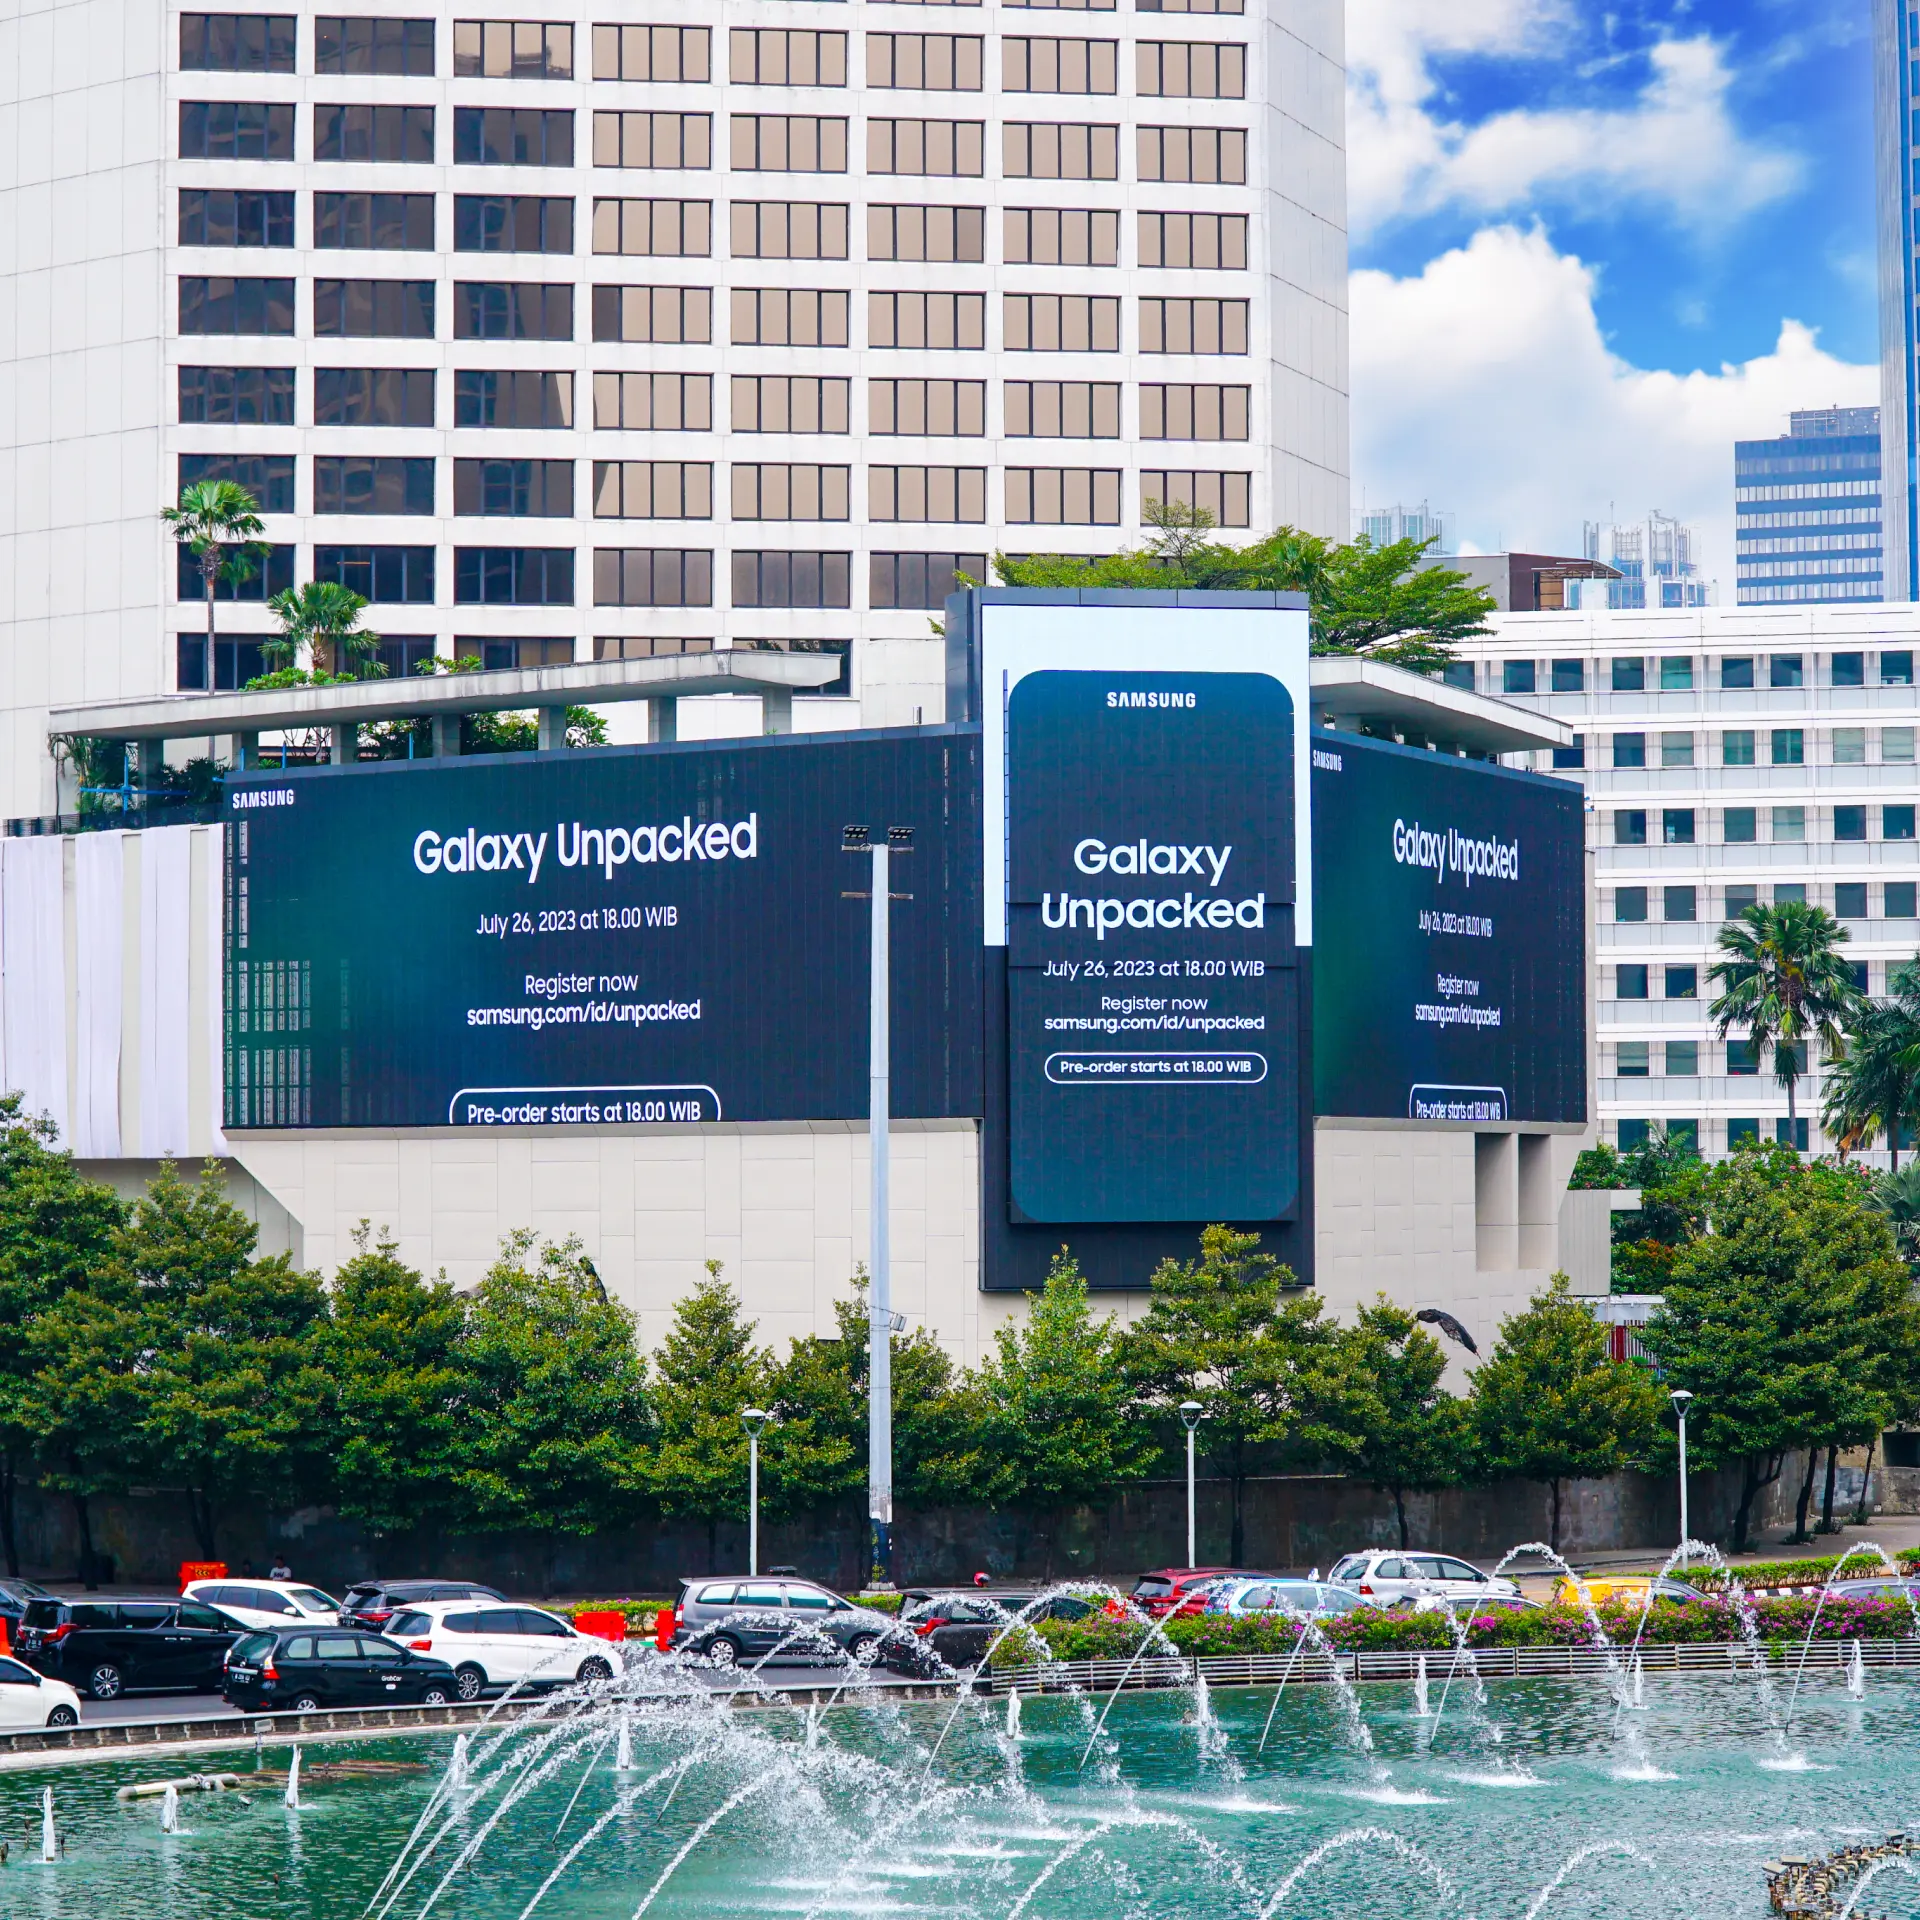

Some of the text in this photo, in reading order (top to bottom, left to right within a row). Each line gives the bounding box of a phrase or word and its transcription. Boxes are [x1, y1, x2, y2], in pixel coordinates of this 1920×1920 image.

[1107, 692, 1195, 707] SAMSUNG
[1313, 750, 1342, 771] SAMSUNG
[233, 789, 294, 809] SAMSUNG
[414, 813, 757, 883] Galaxy Unpacked
[1393, 819, 1518, 887] Galaxy Unpacked
[1074, 839, 1232, 886] Galaxy
[477, 906, 677, 939] July 26, 2023 at 18.00 WIB
[1042, 892, 1264, 940] Unpacked
[1419, 910, 1431, 936] July
[1443, 913, 1457, 933] 2023
[1458, 916, 1465, 934] at
[1466, 916, 1479, 936] 18.00
[1481, 918, 1492, 937] WIB
[1043, 961, 1264, 981] July 26, 2023 at 18.00 WIB
[525, 973, 638, 1000] Register now
[1437, 973, 1479, 999] Register now
[467, 1000, 701, 1030] samsung.com/id/unpacked
[1102, 996, 1208, 1014] Register now
[1045, 1015, 1264, 1033] samsung.com/id/unpacked
[1061, 1061, 1251, 1072] Pre-order starts at 18.00 WIB
[467, 1101, 701, 1124] Pre-order starts at 18.00 WIB
[1416, 1099, 1501, 1120] Pre-order starts at 18.00 WIB
